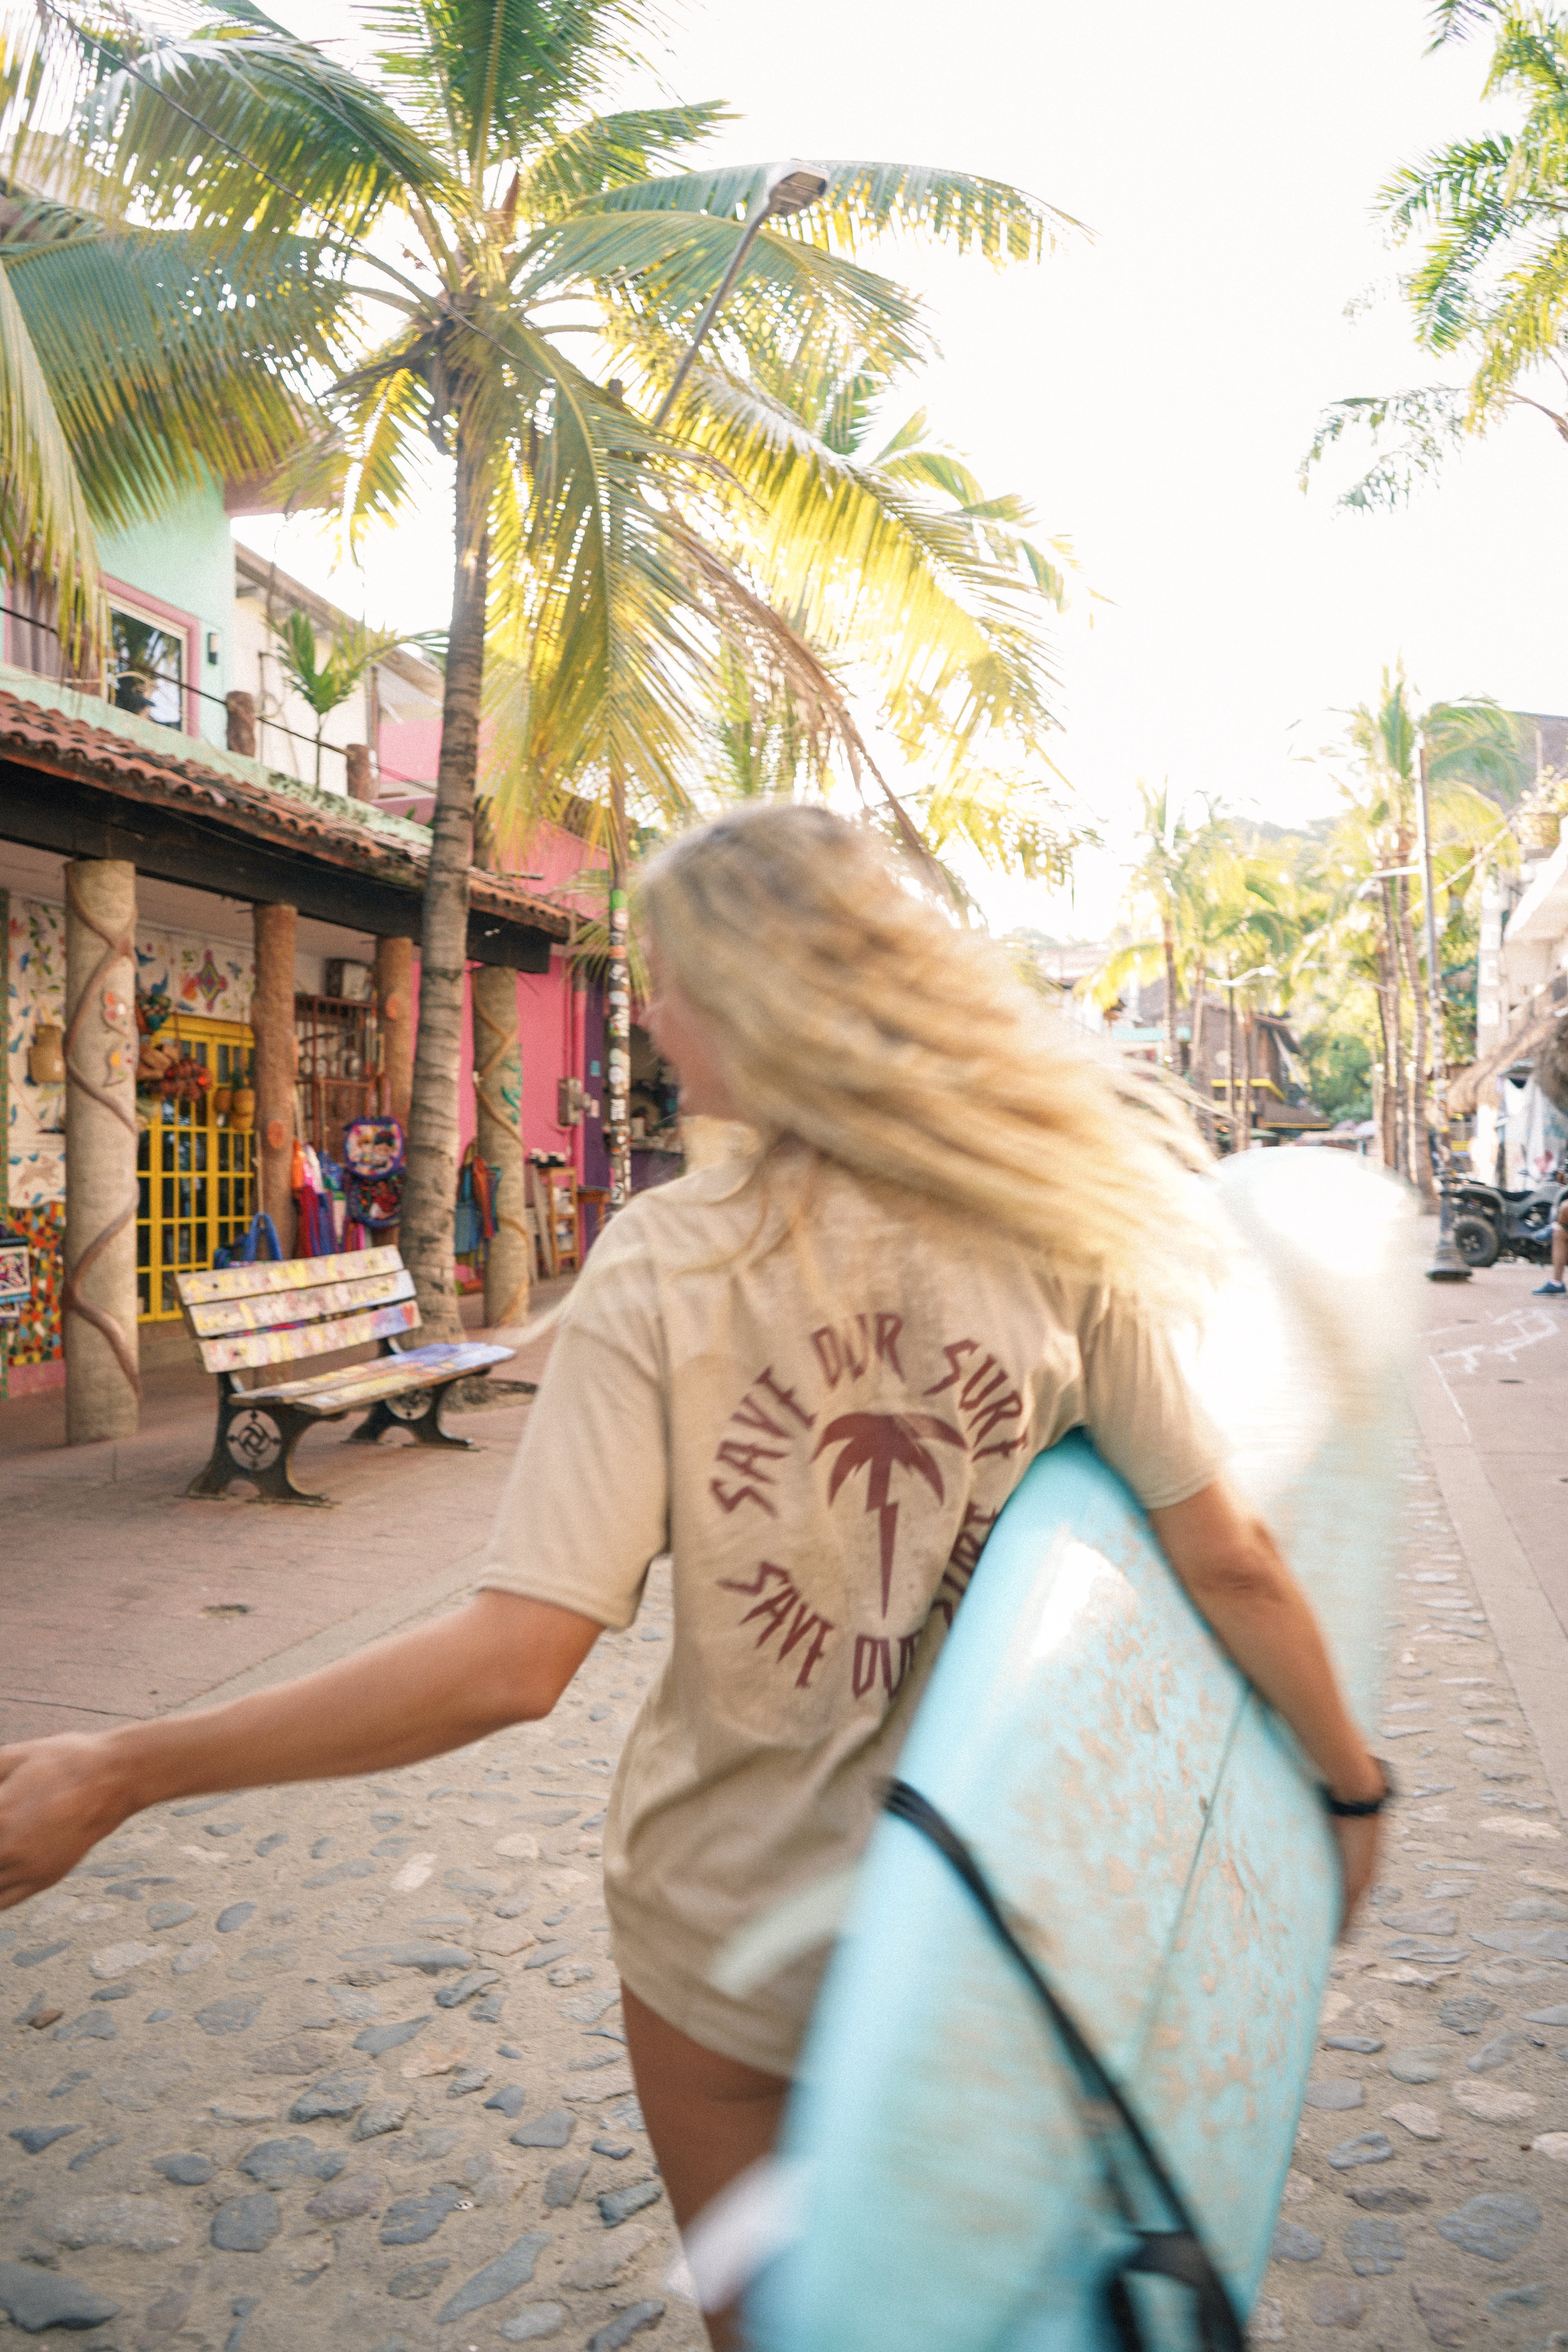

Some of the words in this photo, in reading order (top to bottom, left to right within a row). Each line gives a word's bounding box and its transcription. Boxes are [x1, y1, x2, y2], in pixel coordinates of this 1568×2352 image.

[710, 1365, 817, 1518] SAVE
[811, 1312, 906, 1389] OUR
[921, 1338, 1028, 1462] SURF
[715, 1559, 835, 1690] SAVE
